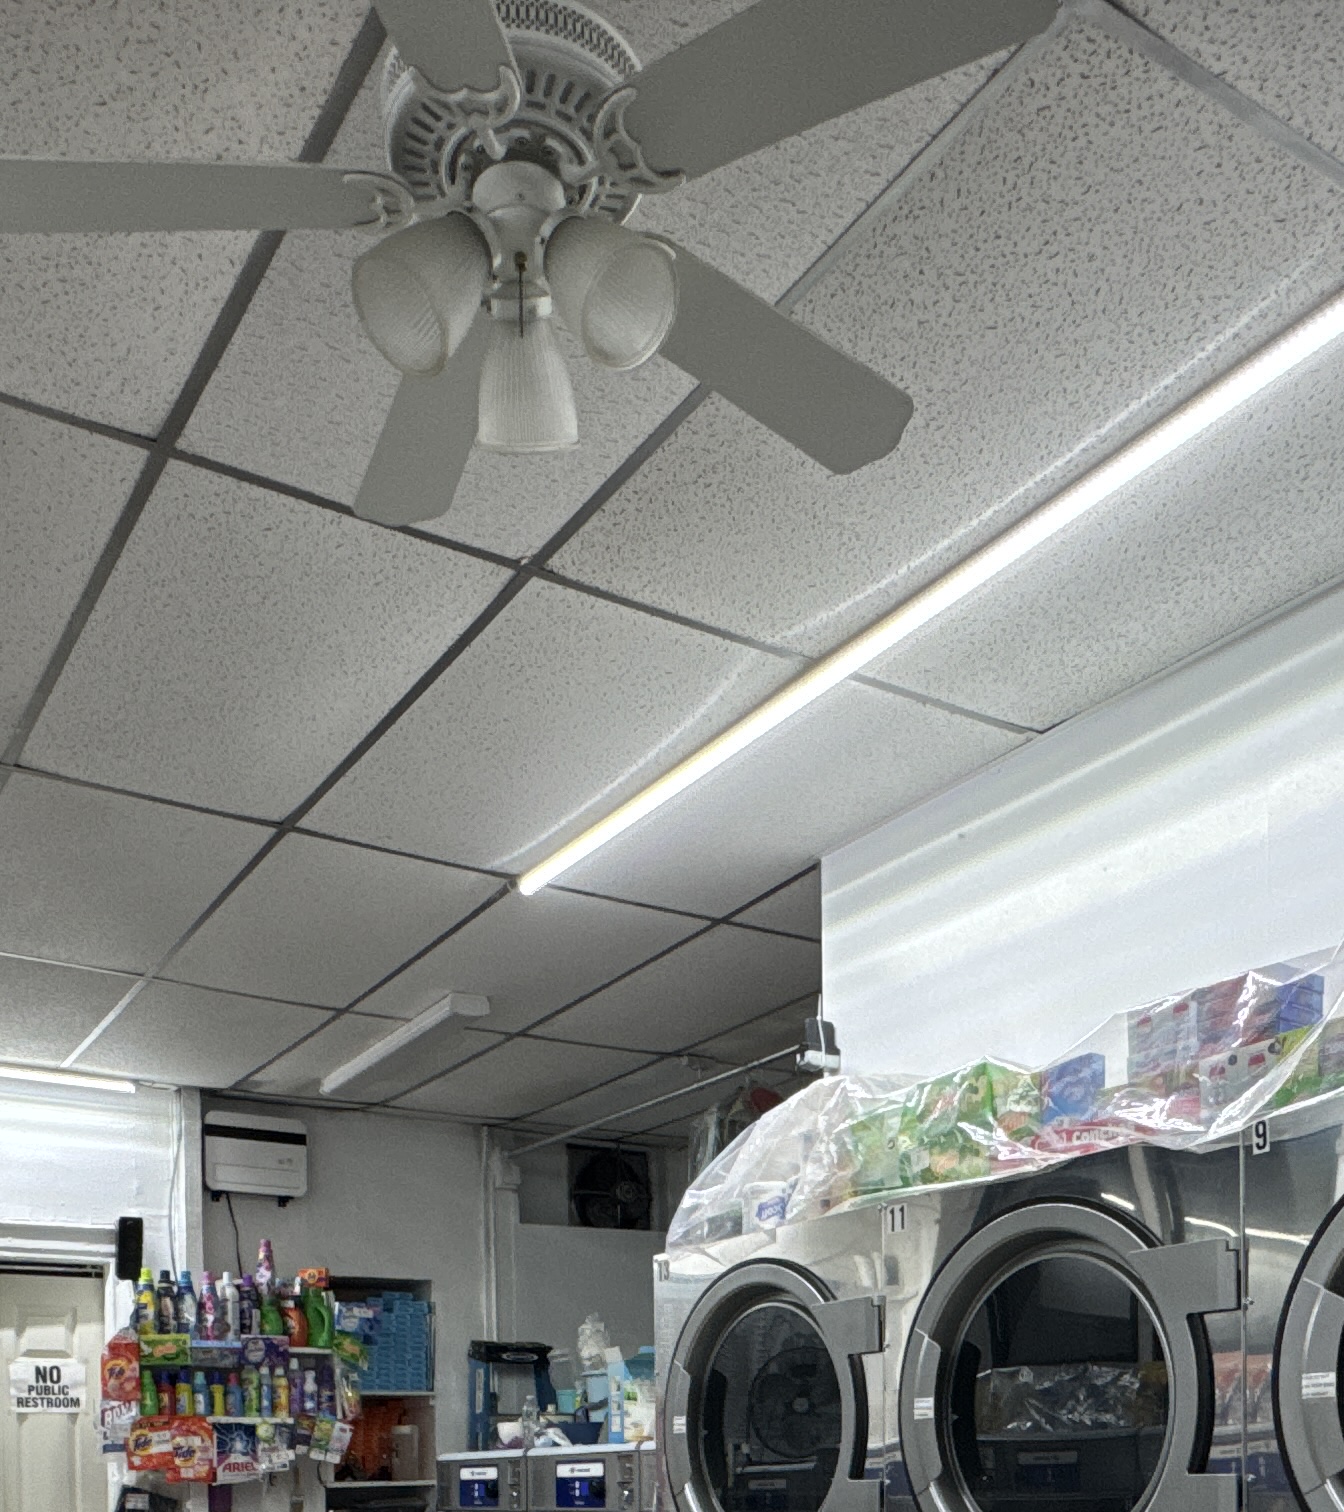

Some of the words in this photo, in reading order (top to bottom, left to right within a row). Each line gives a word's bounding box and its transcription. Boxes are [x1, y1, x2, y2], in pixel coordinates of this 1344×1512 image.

[1254, 1120, 1268, 1151] 9
[888, 1205, 906, 1232] 11
[34, 1365, 62, 1385] NO
[27, 1384, 70, 1396] PUBLIC
[16, 1396, 81, 1409] RESTROOM
